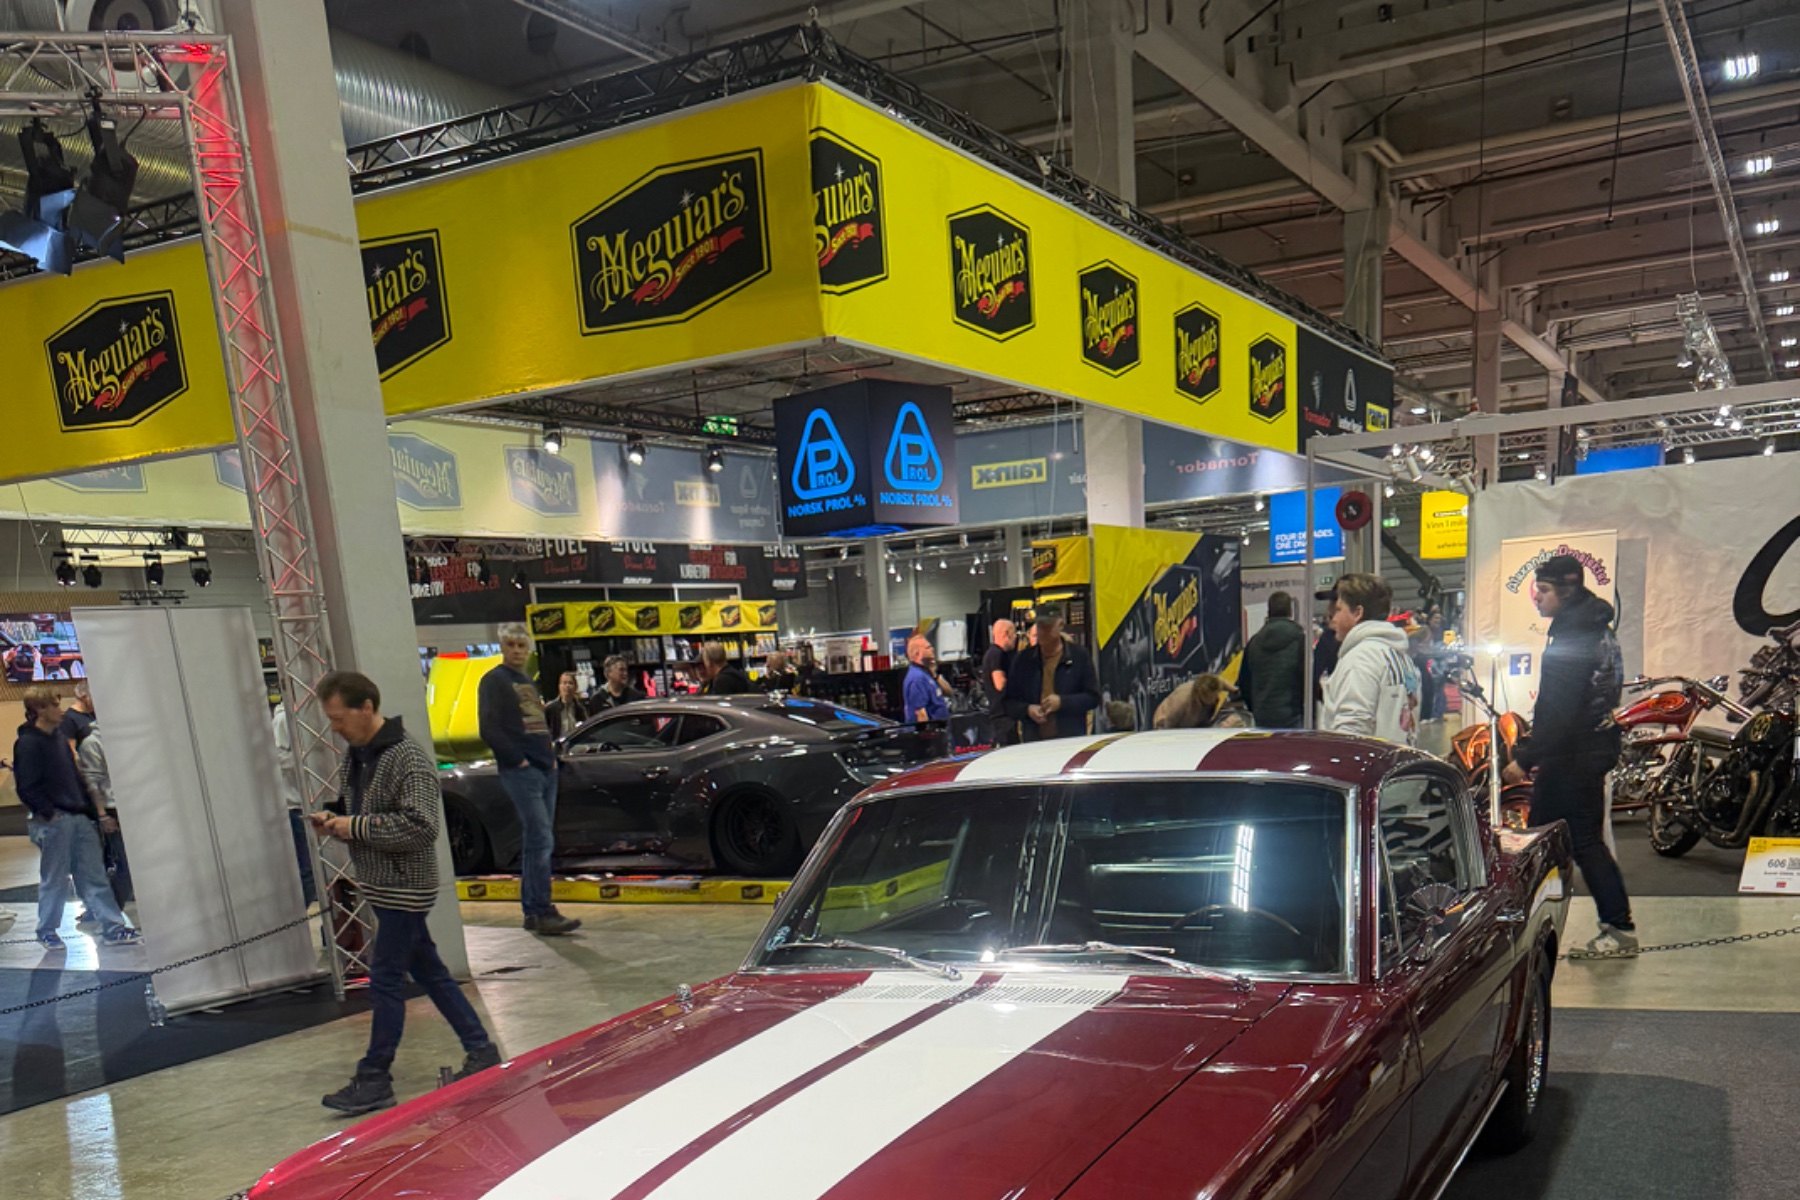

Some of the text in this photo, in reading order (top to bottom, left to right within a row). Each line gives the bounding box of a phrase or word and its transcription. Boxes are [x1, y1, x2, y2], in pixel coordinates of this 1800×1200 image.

[586, 170, 748, 312] Meguiar's
[955, 233, 1026, 309] Meguiar's
[57, 307, 168, 414] Meguiar's
[787, 501, 824, 518] NORSK
[825, 497, 853, 512] PROL
[880, 492, 915, 506] NORSK
[916, 494, 941, 507] PROL
[1768, 858, 1787, 868] 606
